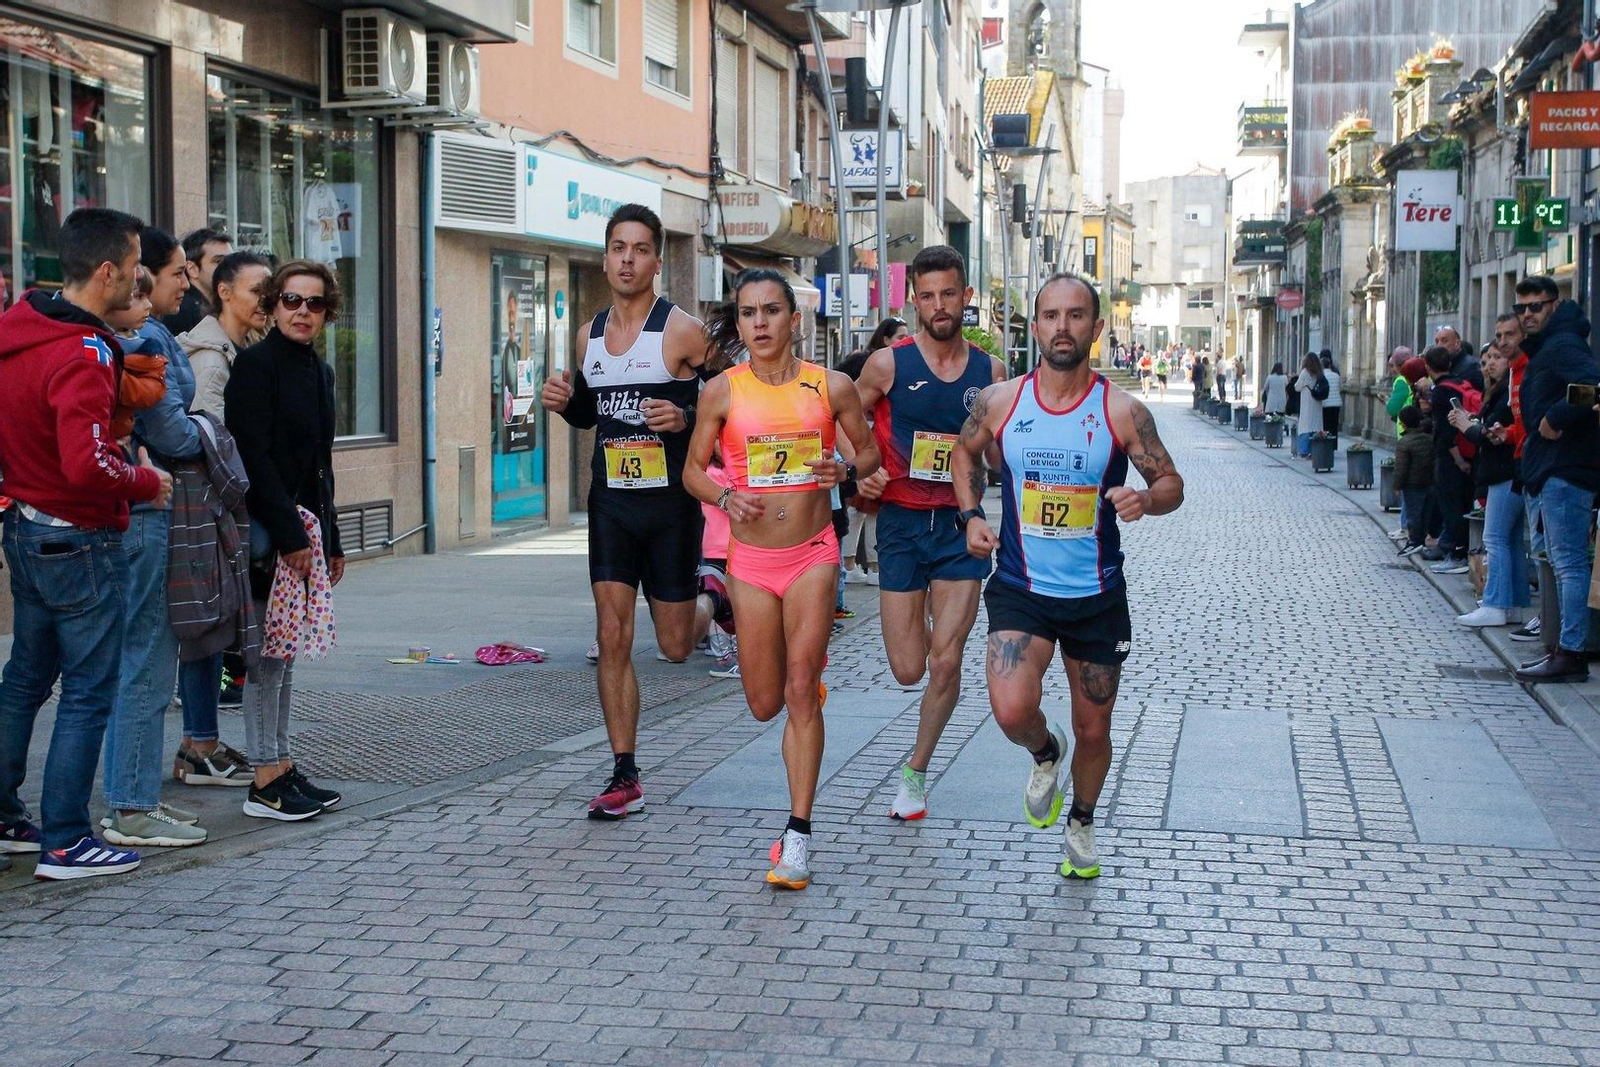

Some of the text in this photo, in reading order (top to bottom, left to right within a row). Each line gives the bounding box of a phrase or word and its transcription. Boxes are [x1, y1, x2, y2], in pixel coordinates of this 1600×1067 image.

[1548, 107, 1598, 117] PACKS Y
[1540, 122, 1600, 132] RECARGA
[1402, 202, 1452, 222] Tere
[1497, 204, 1521, 225] 11
[776, 451, 787, 474] 2
[933, 449, 951, 472] 51
[1026, 451, 1064, 459] CONCELLO
[620, 457, 642, 478] 43
[1042, 473, 1070, 481] XUNTA
[1041, 502, 1069, 528] 62
